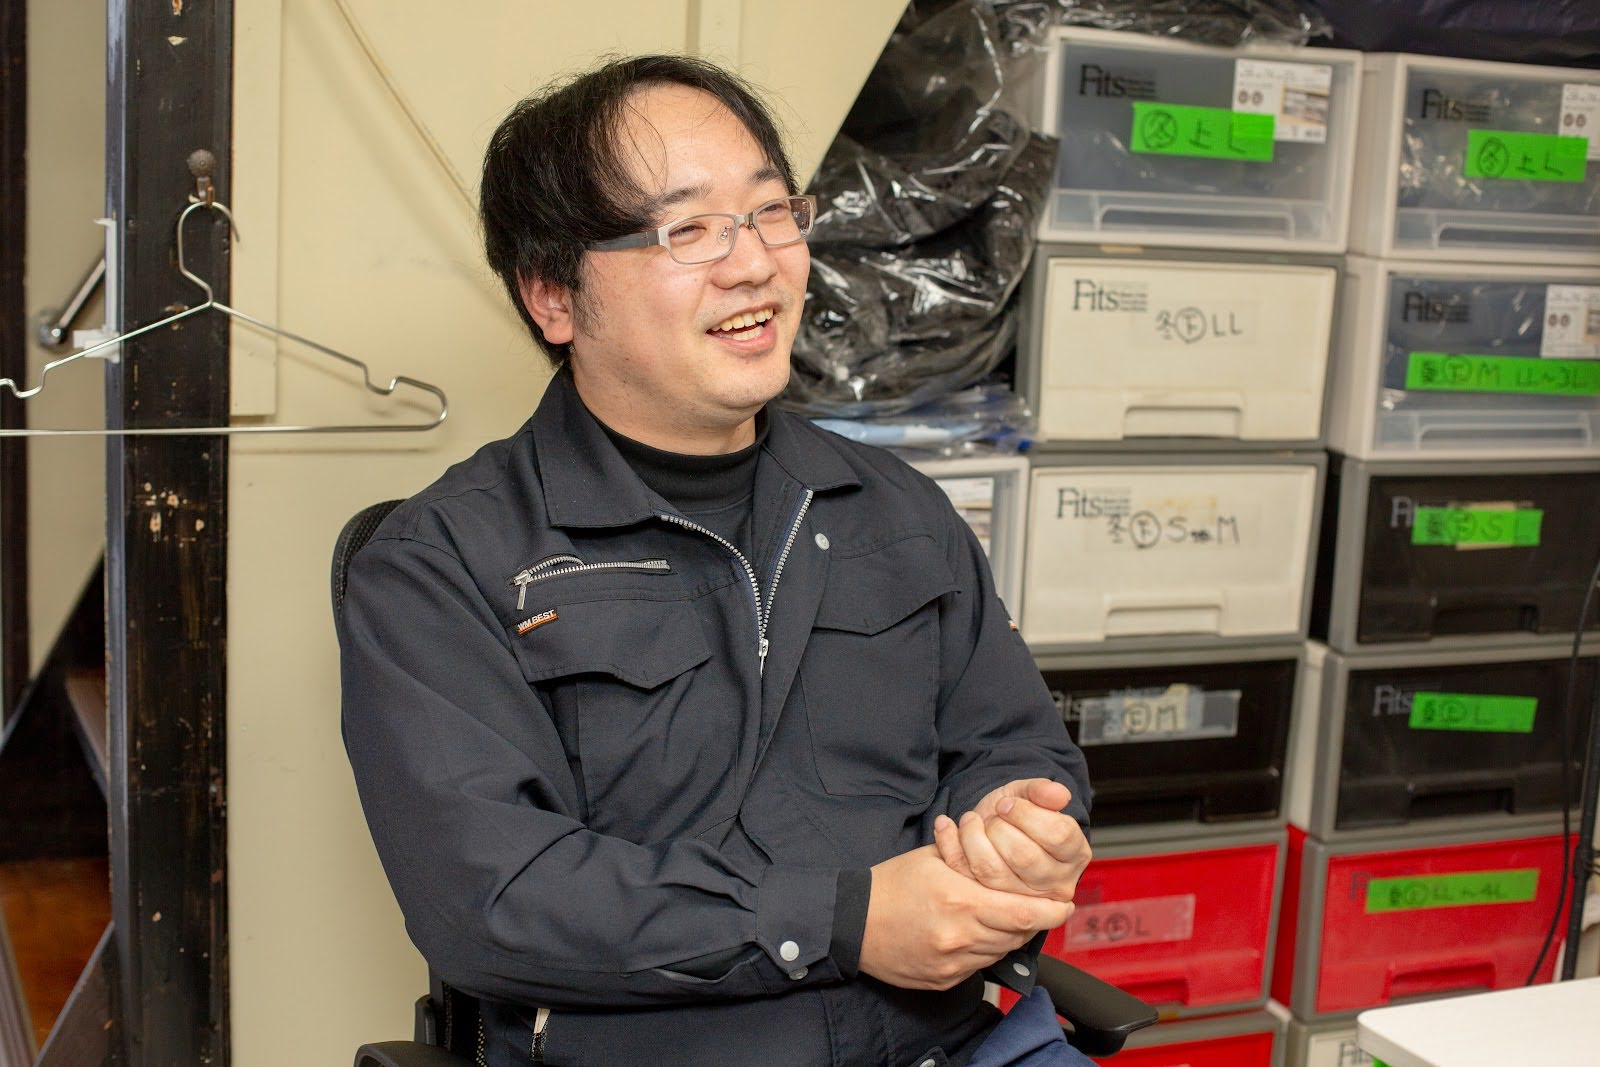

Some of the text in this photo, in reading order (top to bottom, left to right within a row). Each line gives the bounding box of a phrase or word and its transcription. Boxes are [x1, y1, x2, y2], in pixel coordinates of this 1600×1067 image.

[1079, 64, 1126, 99] Fits
[1421, 88, 1464, 121] Fits
[1072, 278, 1120, 313] Fits
[1056, 486, 1104, 519] Fits
[532, 609, 554, 624] BEST
